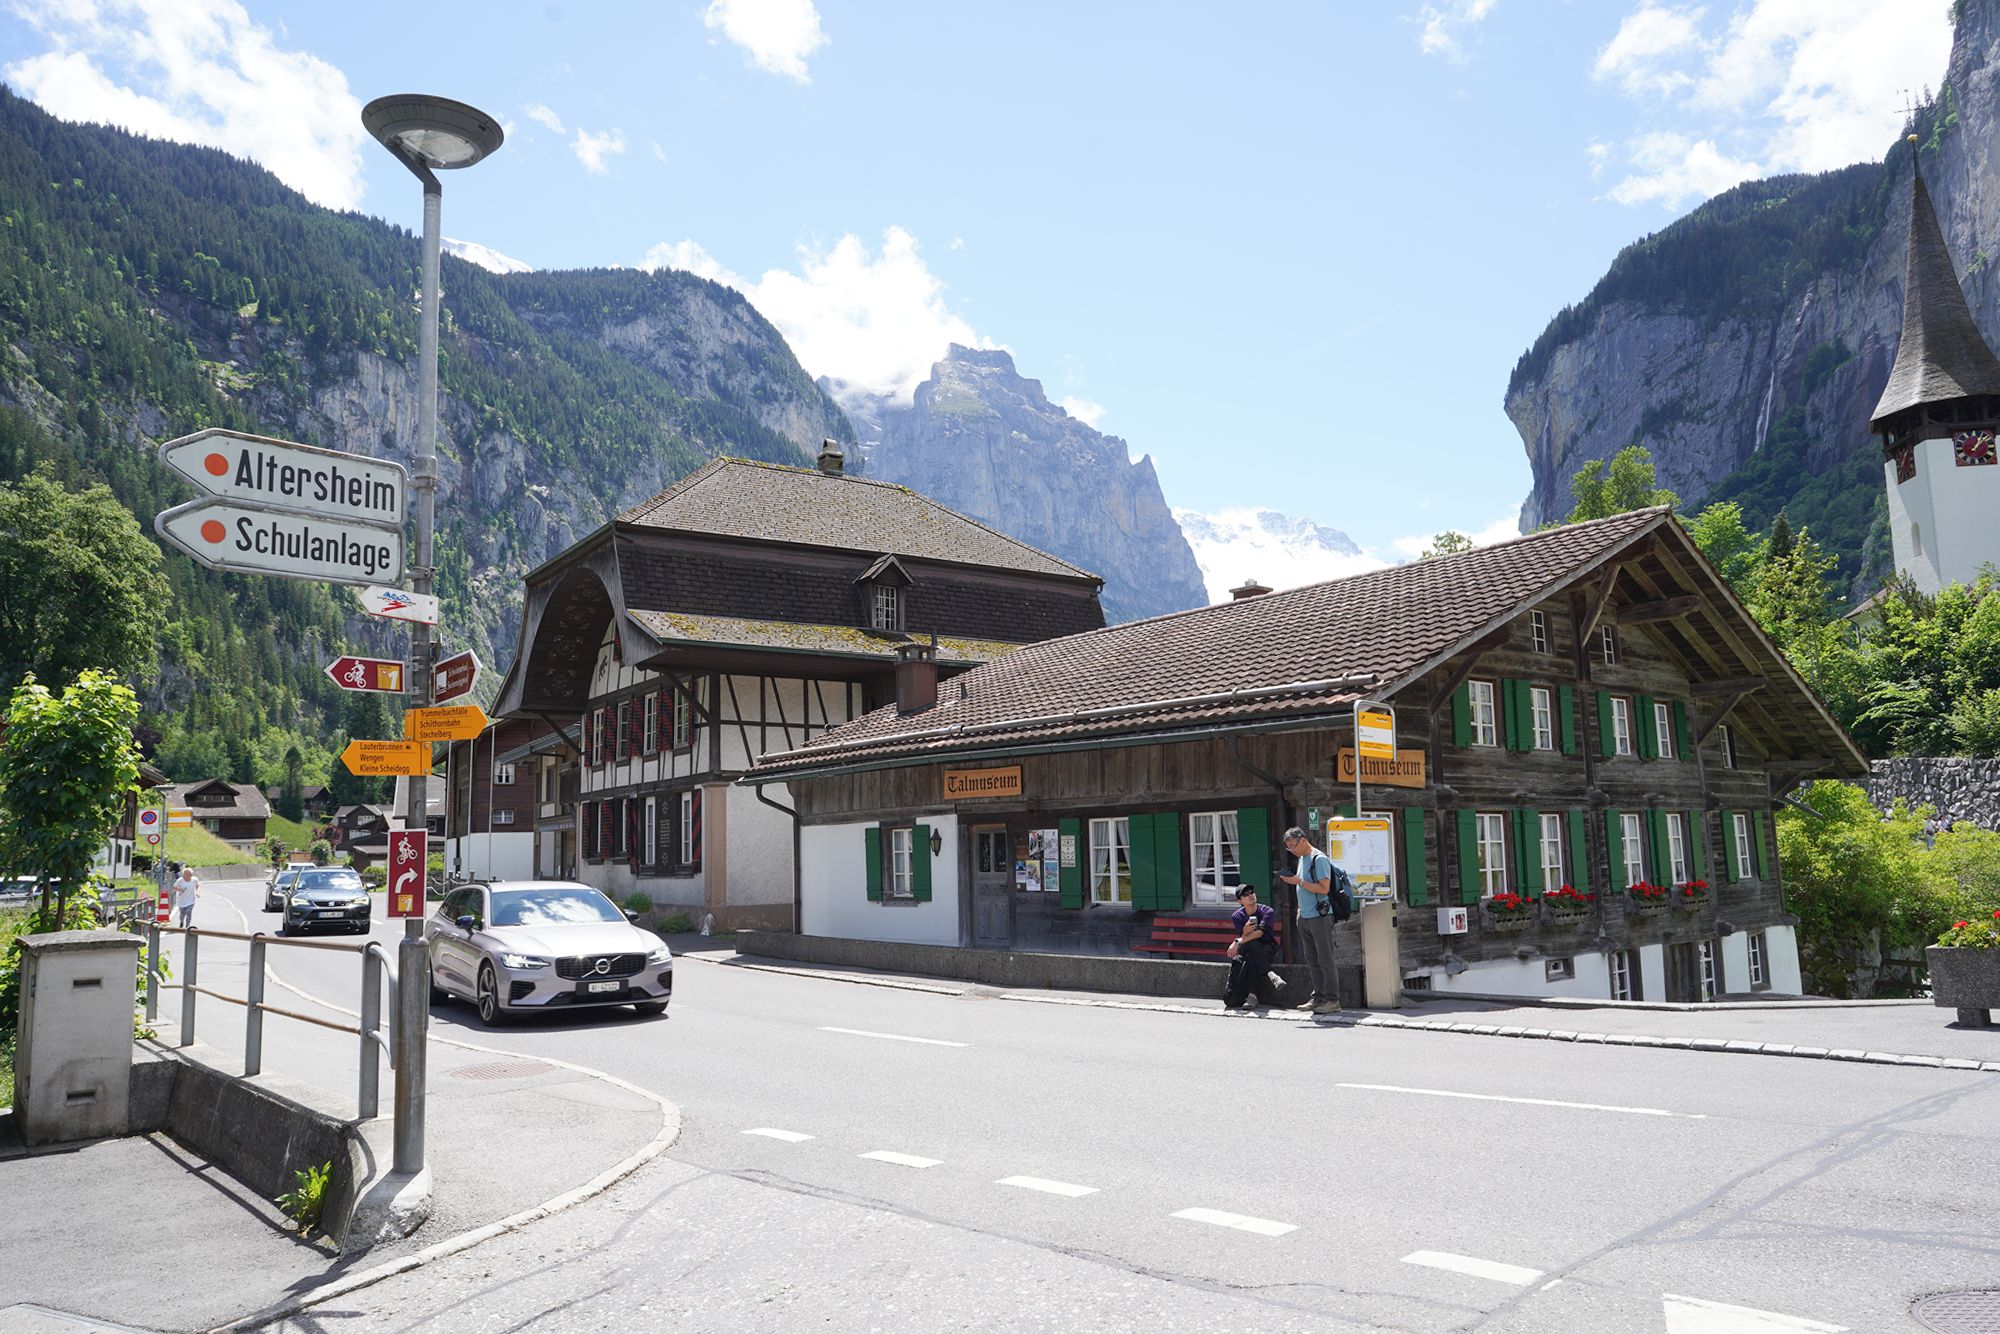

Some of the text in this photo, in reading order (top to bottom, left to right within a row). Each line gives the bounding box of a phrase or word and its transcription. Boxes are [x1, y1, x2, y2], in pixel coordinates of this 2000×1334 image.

[234, 449, 395, 512] Altersheim
[235, 516, 391, 577] Schulanlage
[388, 670, 399, 690] 1
[420, 706, 468, 717] Trümmelbachfälle
[420, 718, 461, 728] Schilthornbahn
[420, 730, 452, 739] Stechelberg
[360, 742, 403, 751] Lauterbrunnen
[360, 753, 384, 763] Wengen
[360, 764, 410, 775] Kleine Scheidegg
[947, 774, 1018, 793] Talmuseum
